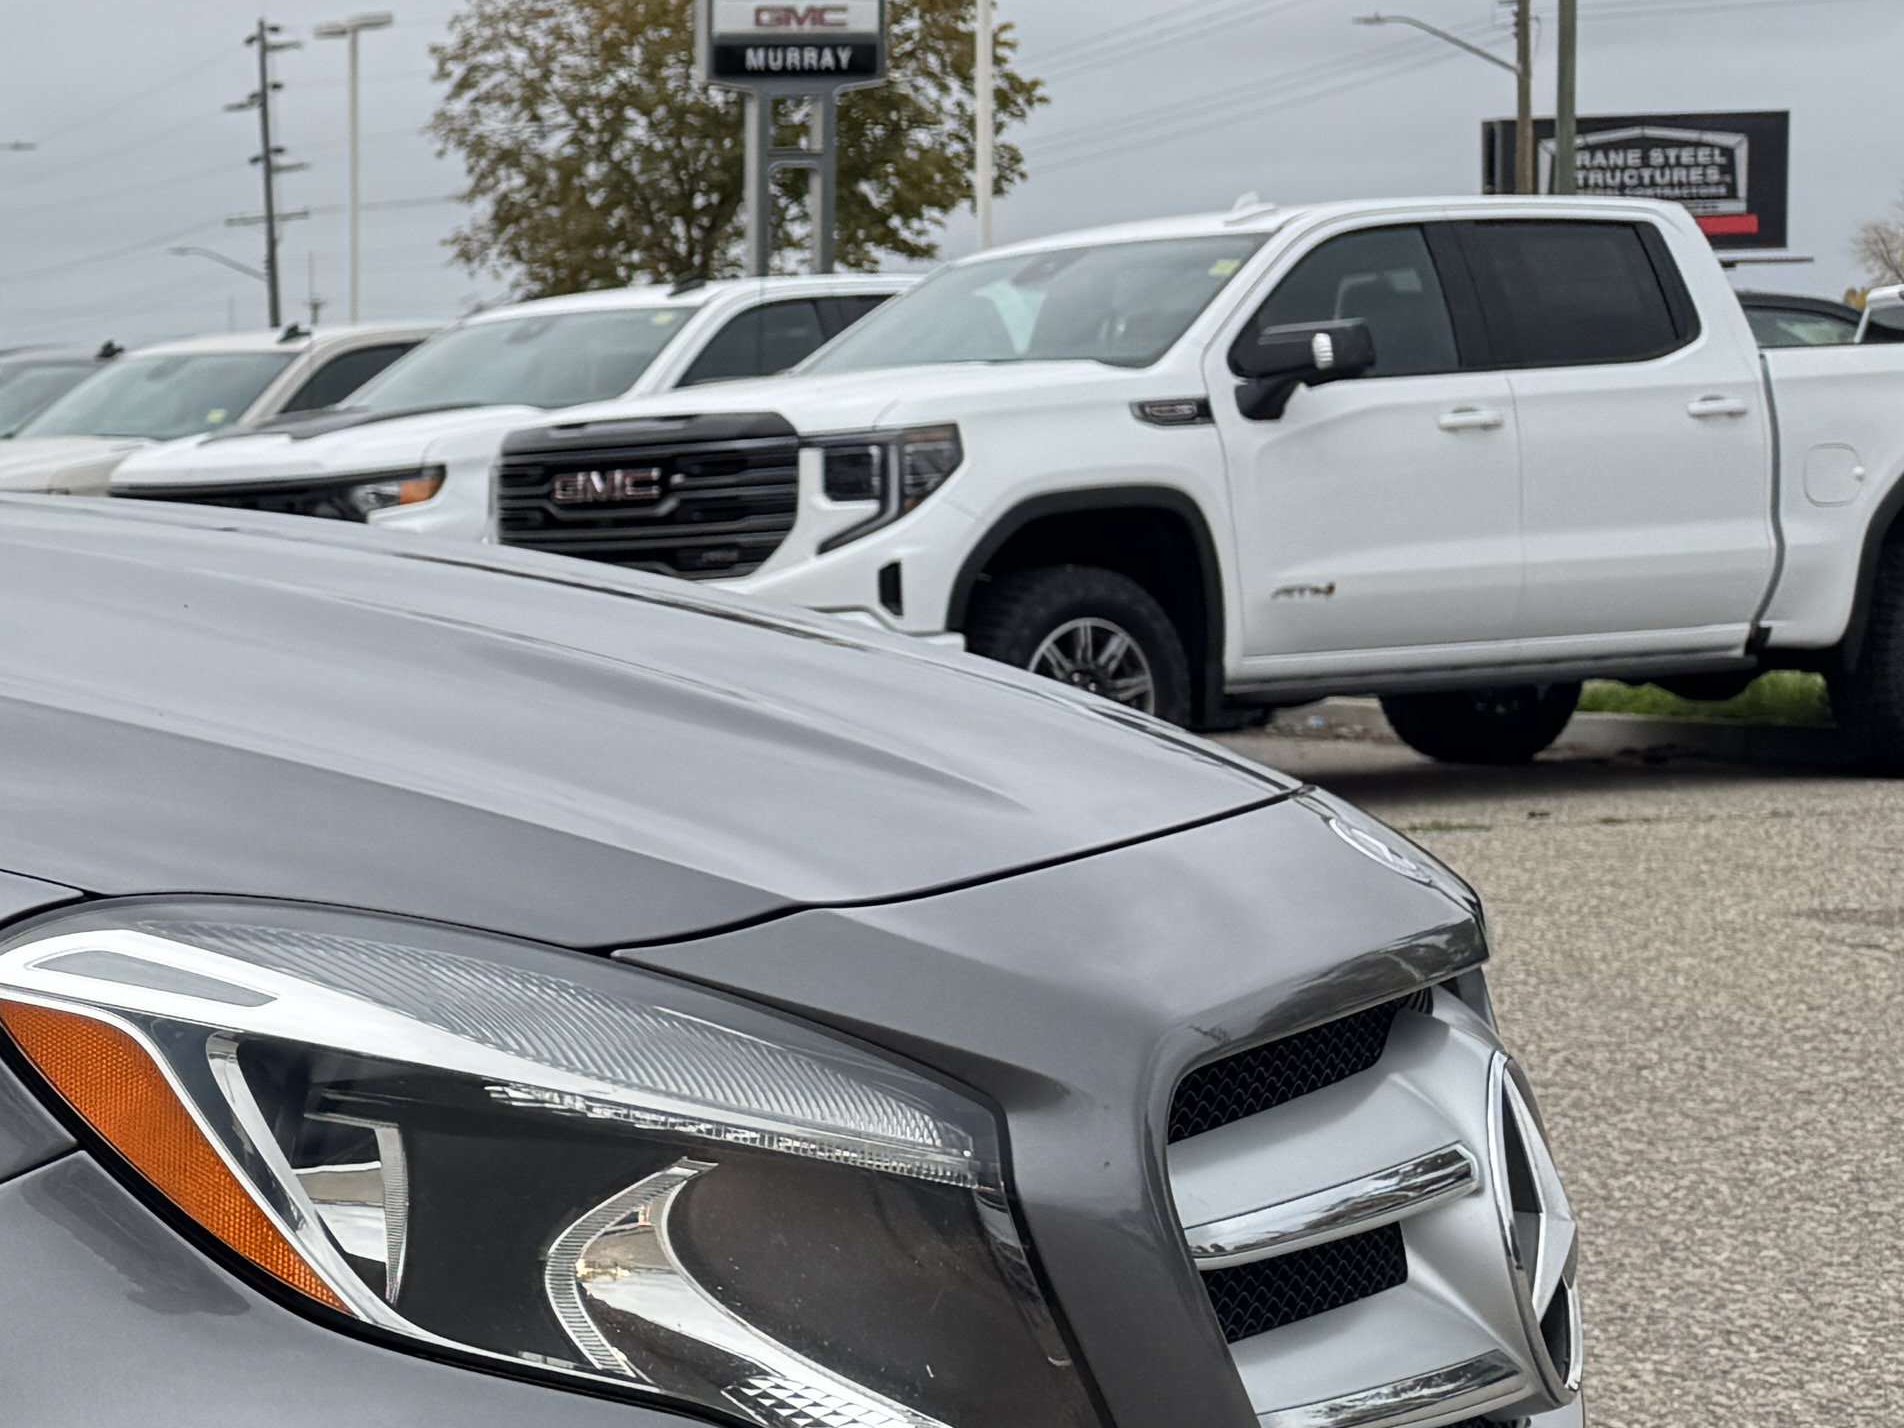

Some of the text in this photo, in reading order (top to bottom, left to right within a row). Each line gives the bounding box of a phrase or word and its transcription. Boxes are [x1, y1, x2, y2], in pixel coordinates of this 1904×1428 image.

[754, 5, 848, 27] GMC
[744, 46, 852, 71] MURRAY
[1575, 146, 1727, 168] RANE STEEL
[1575, 166, 1721, 187] TRUCTURES
[552, 466, 663, 503] GMC
